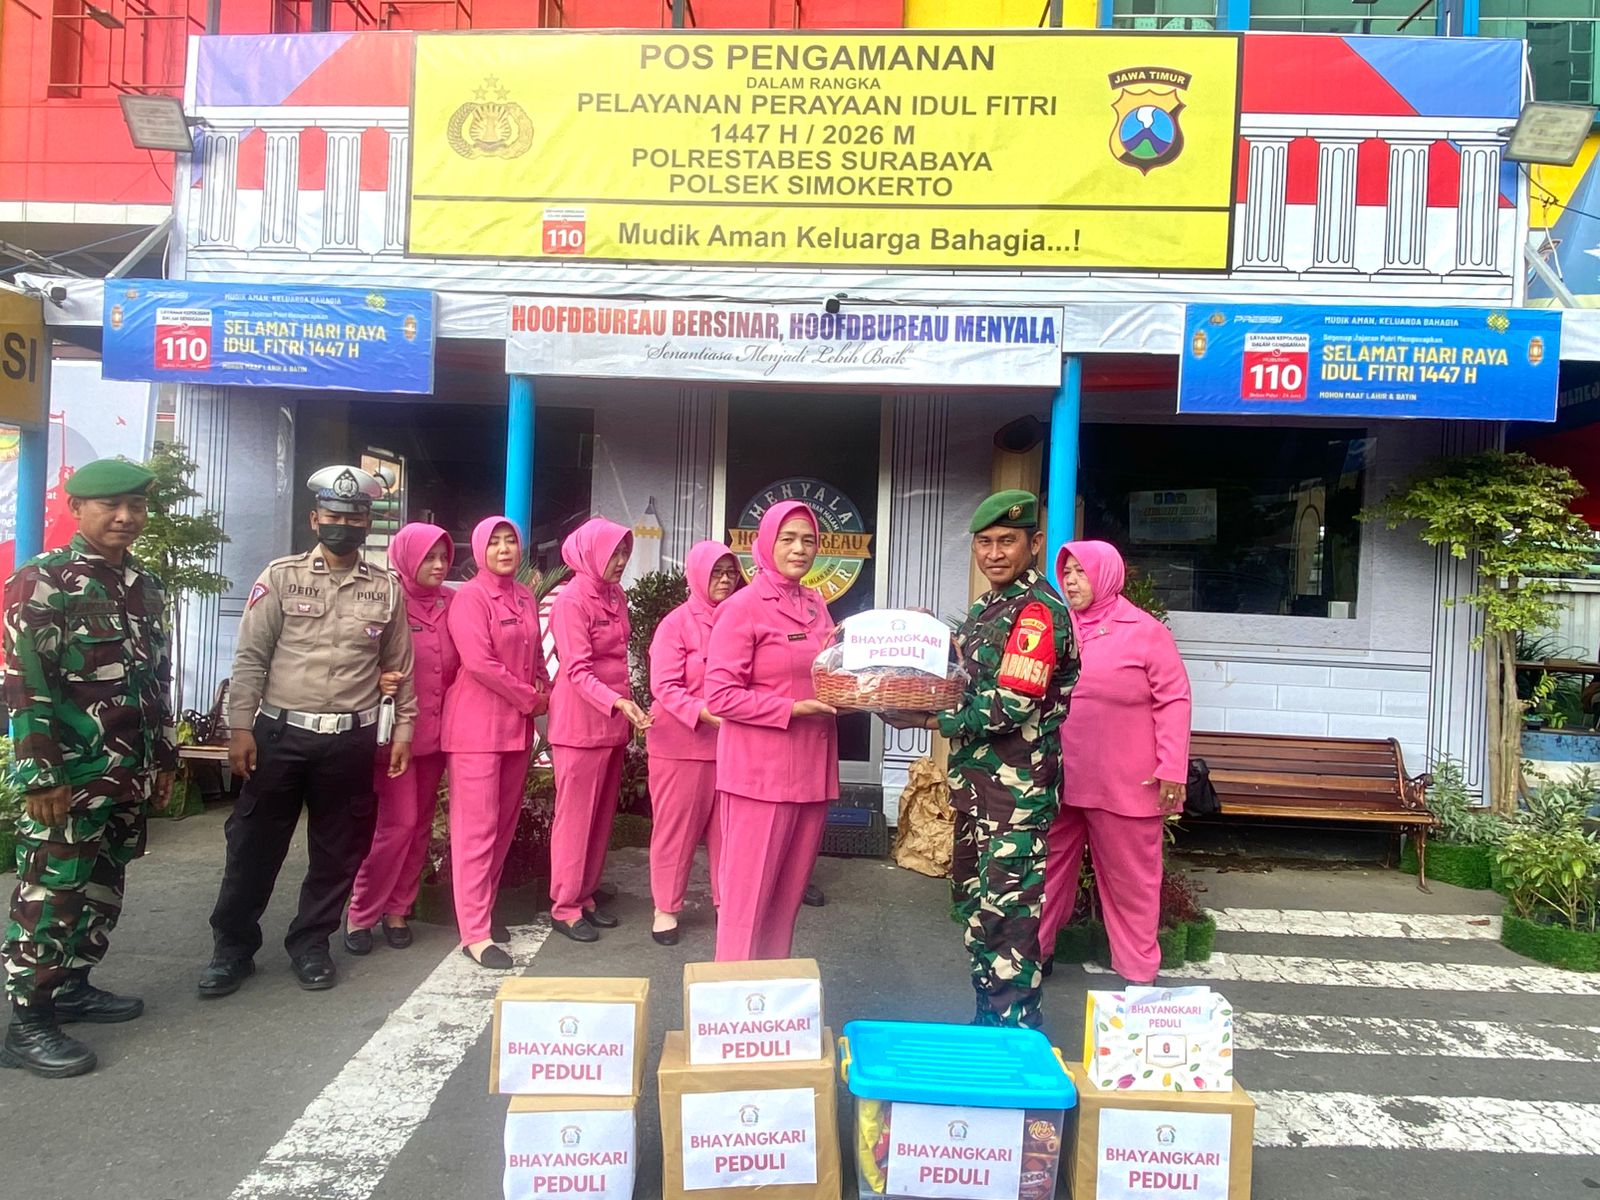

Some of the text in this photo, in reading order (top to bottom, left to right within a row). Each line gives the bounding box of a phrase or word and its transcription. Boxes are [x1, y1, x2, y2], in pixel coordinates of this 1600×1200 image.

[640, 44, 995, 71] POS PENGAMANAN
[746, 77, 882, 90] DALAM RANGKA
[1113, 70, 1187, 86] JAWA TIMUR
[577, 93, 1057, 116] PELAYANAN PERAYAAN IDUL FITRI
[710, 124, 916, 145] 1447 H / 2026 M
[632, 148, 993, 171] POLRESTABES SURABAYA
[669, 174, 953, 196] POLSEK SIMOKERTO
[547, 228, 583, 247] 110
[618, 222, 699, 246] Mudik
[707, 225, 786, 248] Aman
[796, 226, 921, 255] Keluarga
[224, 319, 387, 341] SELAMAT HARI RAYA
[512, 304, 1055, 344] HOOFDBUREAU BERSINAR, HOOFDBUREAU MENYALA
[162, 336, 208, 361] 110
[224, 338, 359, 358] IDUL FITRI 1447 H
[1322, 344, 1509, 366] SELAMAT HARI RAYA
[735, 344, 806, 377] Menjadi
[811, 342, 860, 364] Lebih
[1250, 364, 1303, 391] 110
[1321, 364, 1477, 384] IDUL FITRI 1447 H
[748, 482, 854, 525] MENYALA
[288, 584, 320, 598] DEDY
[357, 591, 387, 602] POLRI
[851, 633, 942, 649] BHAYANGKARI
[869, 647, 925, 660] PEDULI
[1131, 1004, 1202, 1015] BHAYANGKARI
[698, 1017, 811, 1036] BHAYANGKARI
[1149, 1018, 1181, 1028] PEDULI
[508, 1041, 624, 1057] BHAYANGKARI
[722, 1040, 791, 1059] PEDULI
[531, 1063, 602, 1081] PEDULI
[690, 1130, 806, 1149] BHAYANGKARI
[510, 1151, 628, 1168] BHAYANGKARI
[897, 1143, 1013, 1162] BHAYANGKARI
[1106, 1147, 1220, 1166] BHAYANGKARI
[715, 1153, 786, 1173] PEDULI
[533, 1175, 606, 1193] PEDULI
[919, 1166, 990, 1186] PEDULI
[1128, 1170, 1199, 1191] PEDULI
